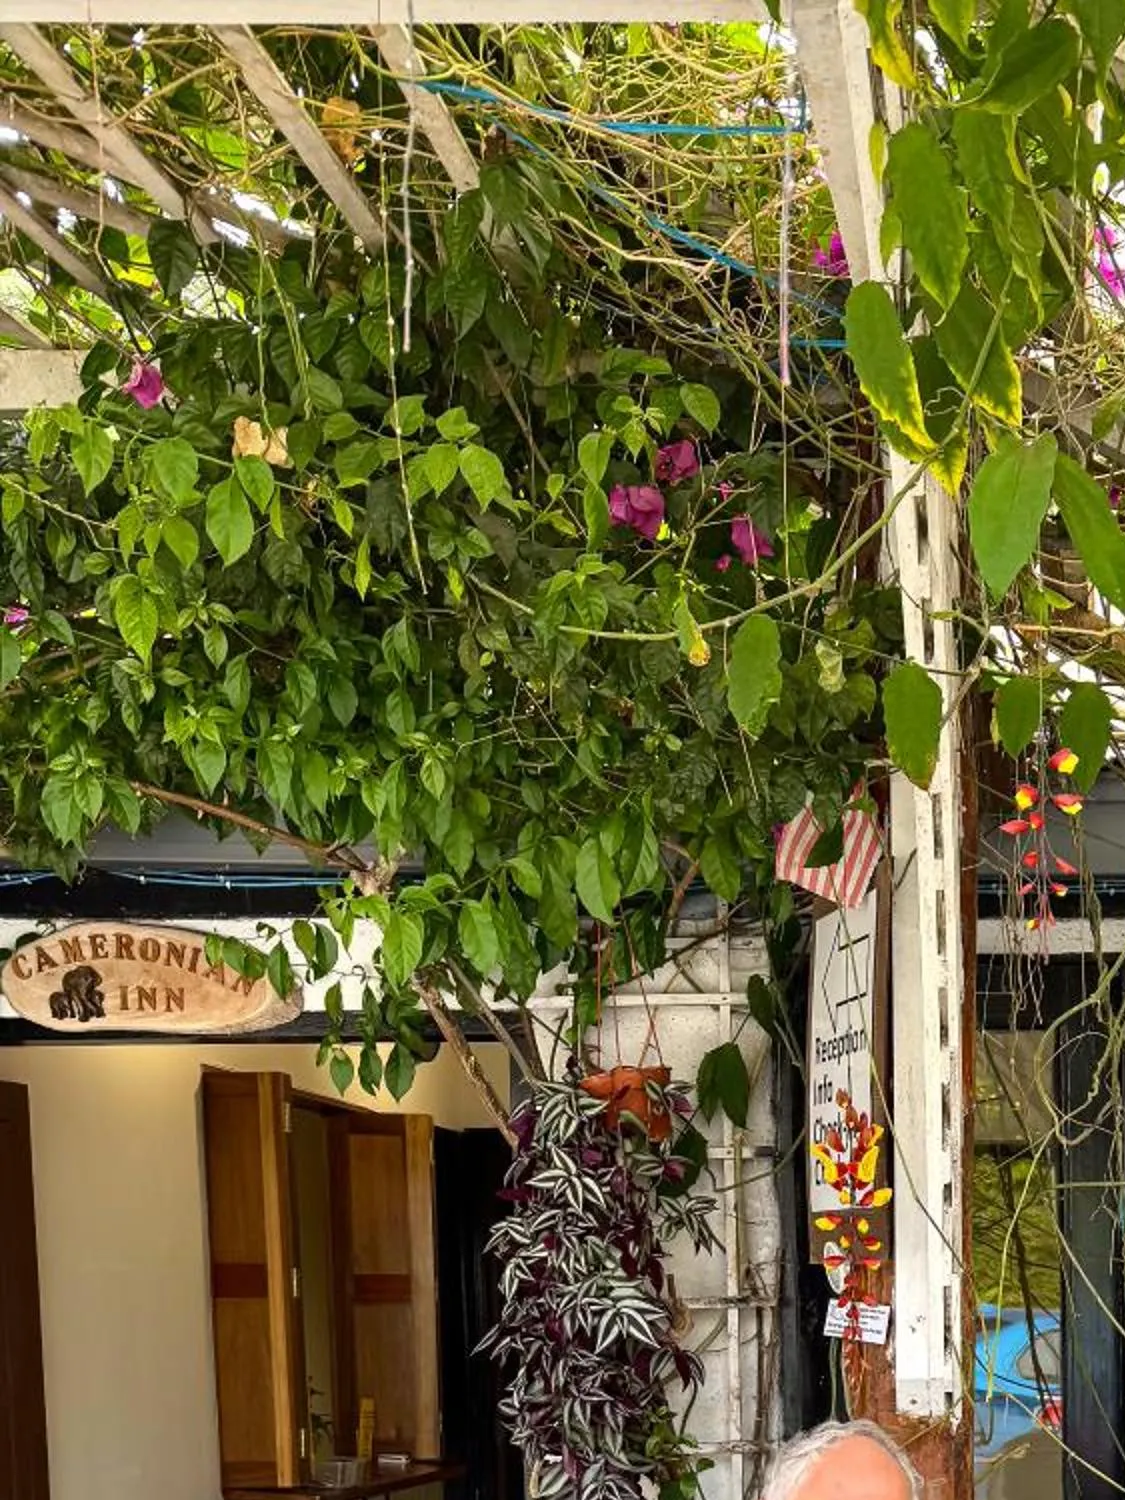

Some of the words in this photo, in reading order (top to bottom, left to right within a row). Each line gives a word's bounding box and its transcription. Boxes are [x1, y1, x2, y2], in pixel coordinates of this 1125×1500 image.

[118, 984, 186, 1012] INN
[815, 1027, 867, 1064] Reception
[813, 1074, 833, 1106] Info
